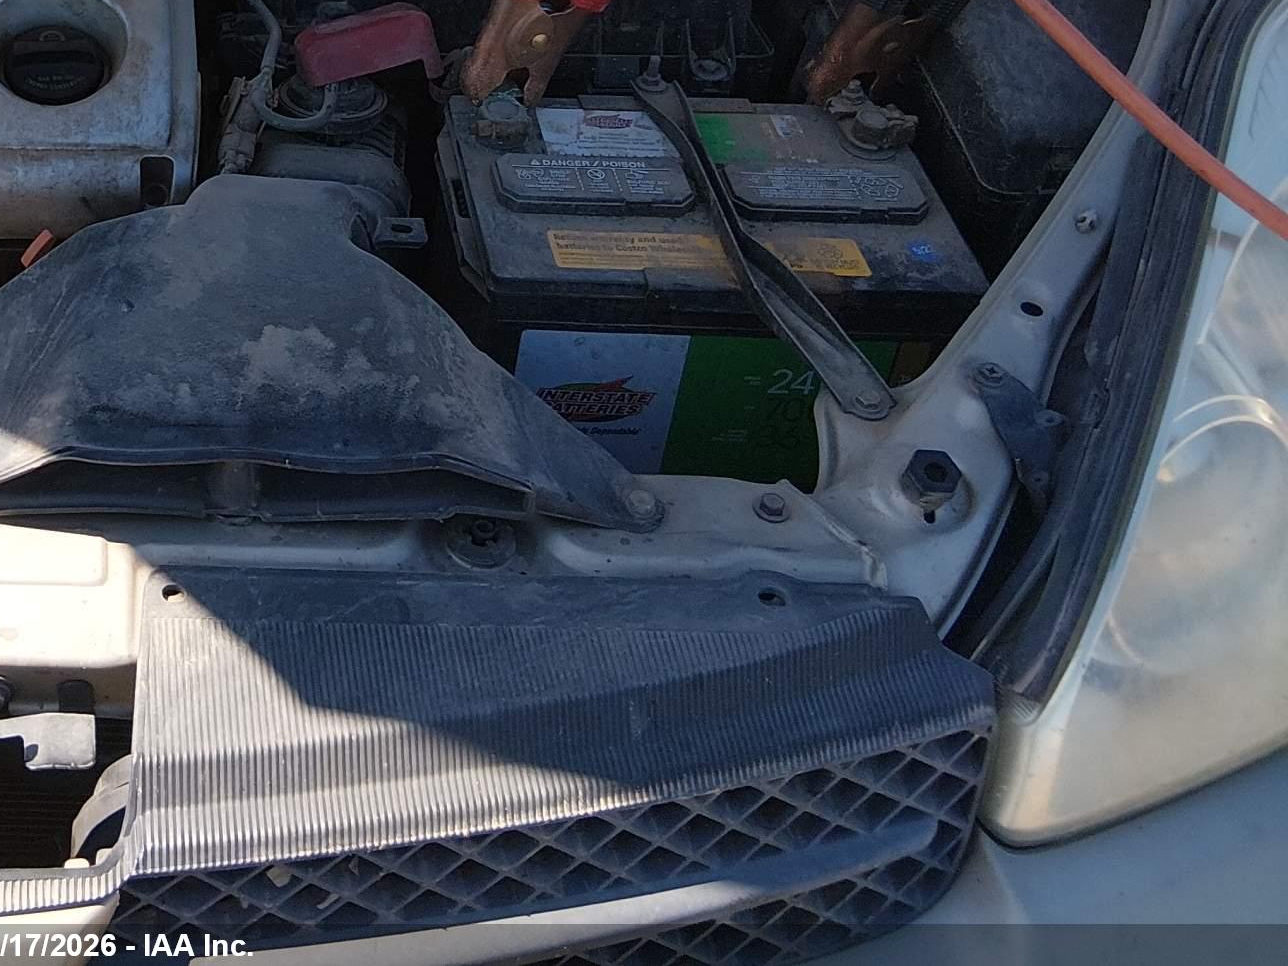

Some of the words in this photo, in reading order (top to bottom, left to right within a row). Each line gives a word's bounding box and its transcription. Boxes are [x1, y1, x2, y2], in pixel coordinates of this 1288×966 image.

[542, 159, 591, 167] DANGER
[602, 160, 646, 168] POISON
[538, 389, 651, 403] INTERSTATE
